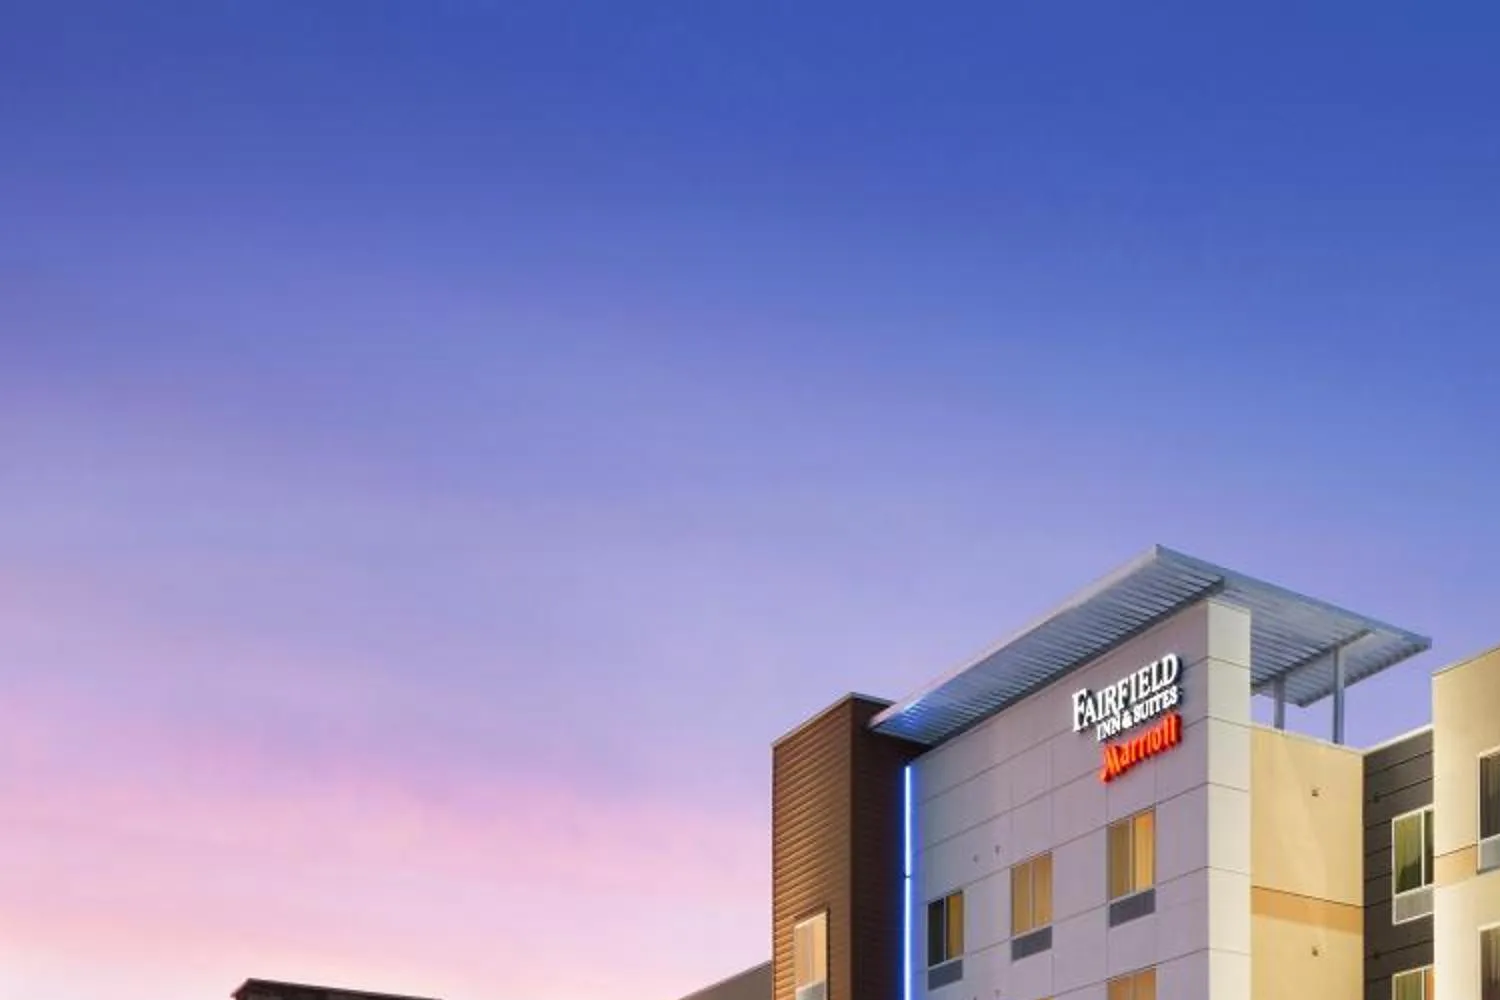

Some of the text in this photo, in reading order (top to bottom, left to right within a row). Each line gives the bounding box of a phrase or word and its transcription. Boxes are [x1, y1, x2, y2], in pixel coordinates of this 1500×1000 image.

[1072, 652, 1179, 732] FAIRFIELD
[1096, 685, 1179, 741] INN & SUITES
[1100, 711, 1181, 782] Marriott
